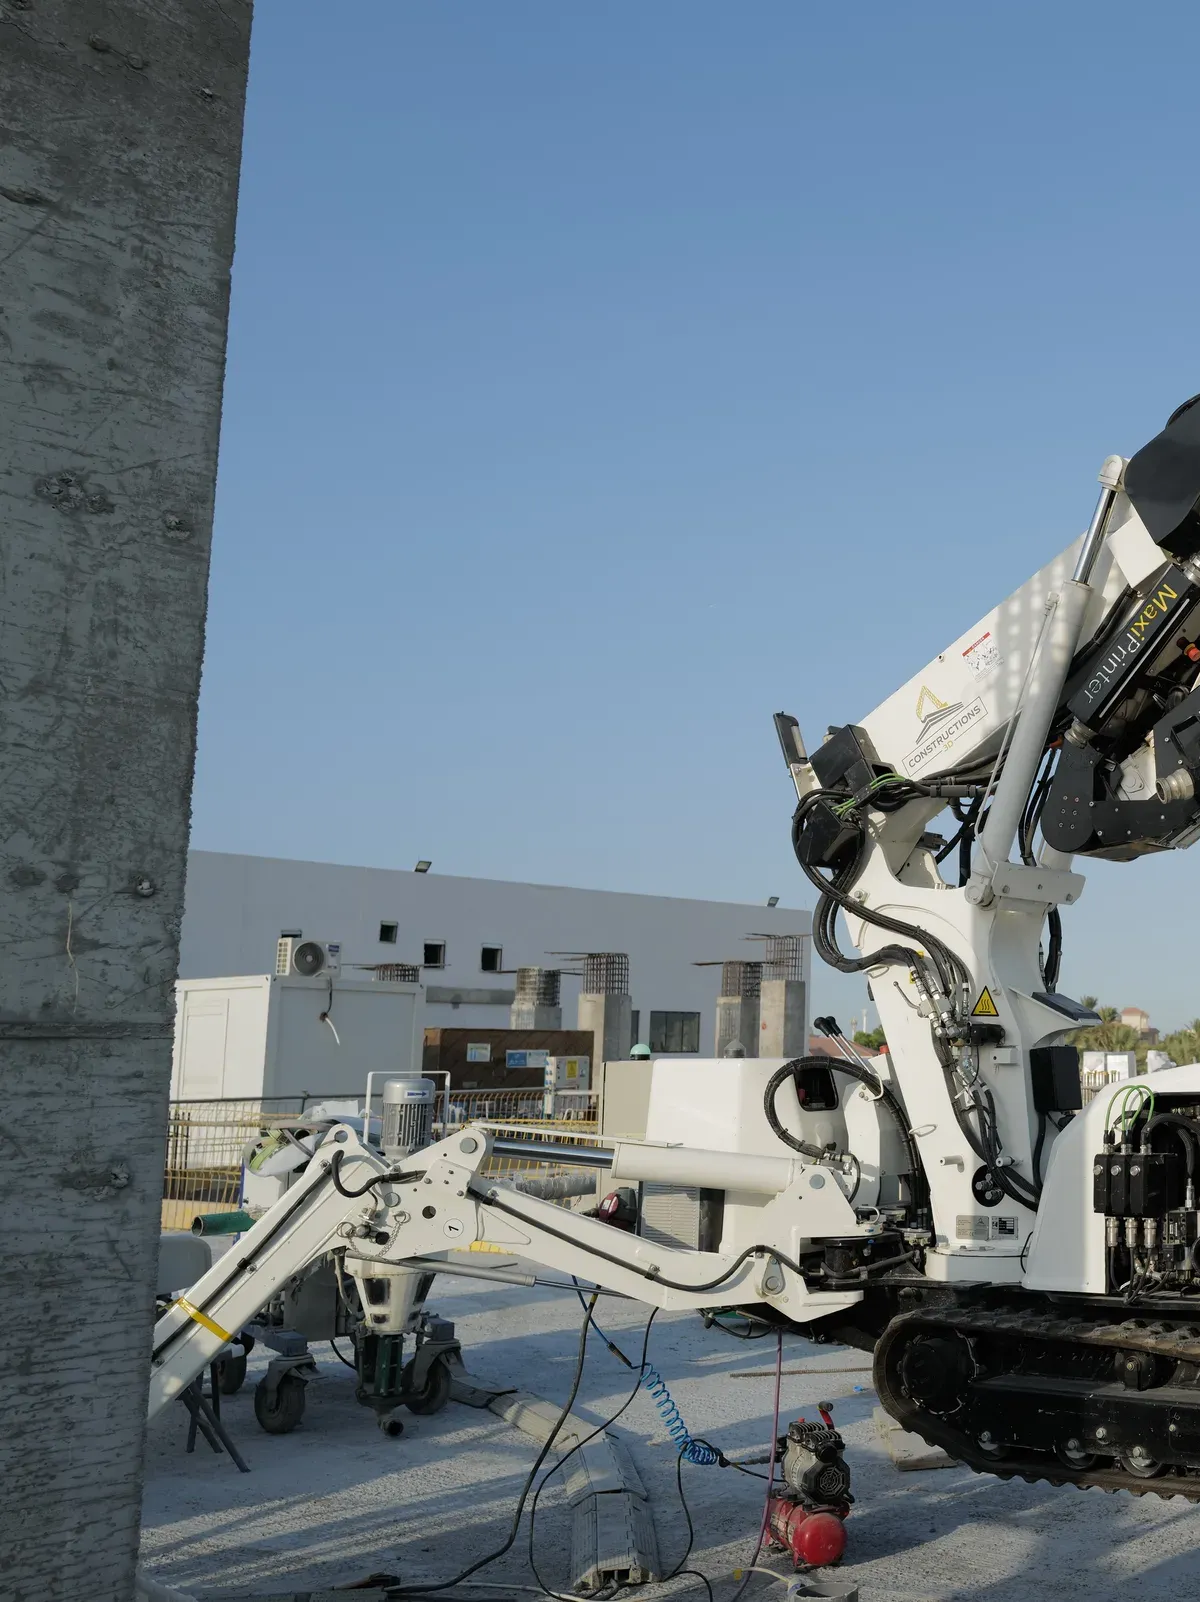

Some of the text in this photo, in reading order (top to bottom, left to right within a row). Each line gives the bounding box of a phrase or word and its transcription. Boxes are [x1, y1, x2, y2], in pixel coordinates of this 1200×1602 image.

[1086, 583, 1178, 704] MaxiPrinter
[908, 703, 982, 769] CONSTRUCTIONS
[942, 740, 954, 752] 3D
